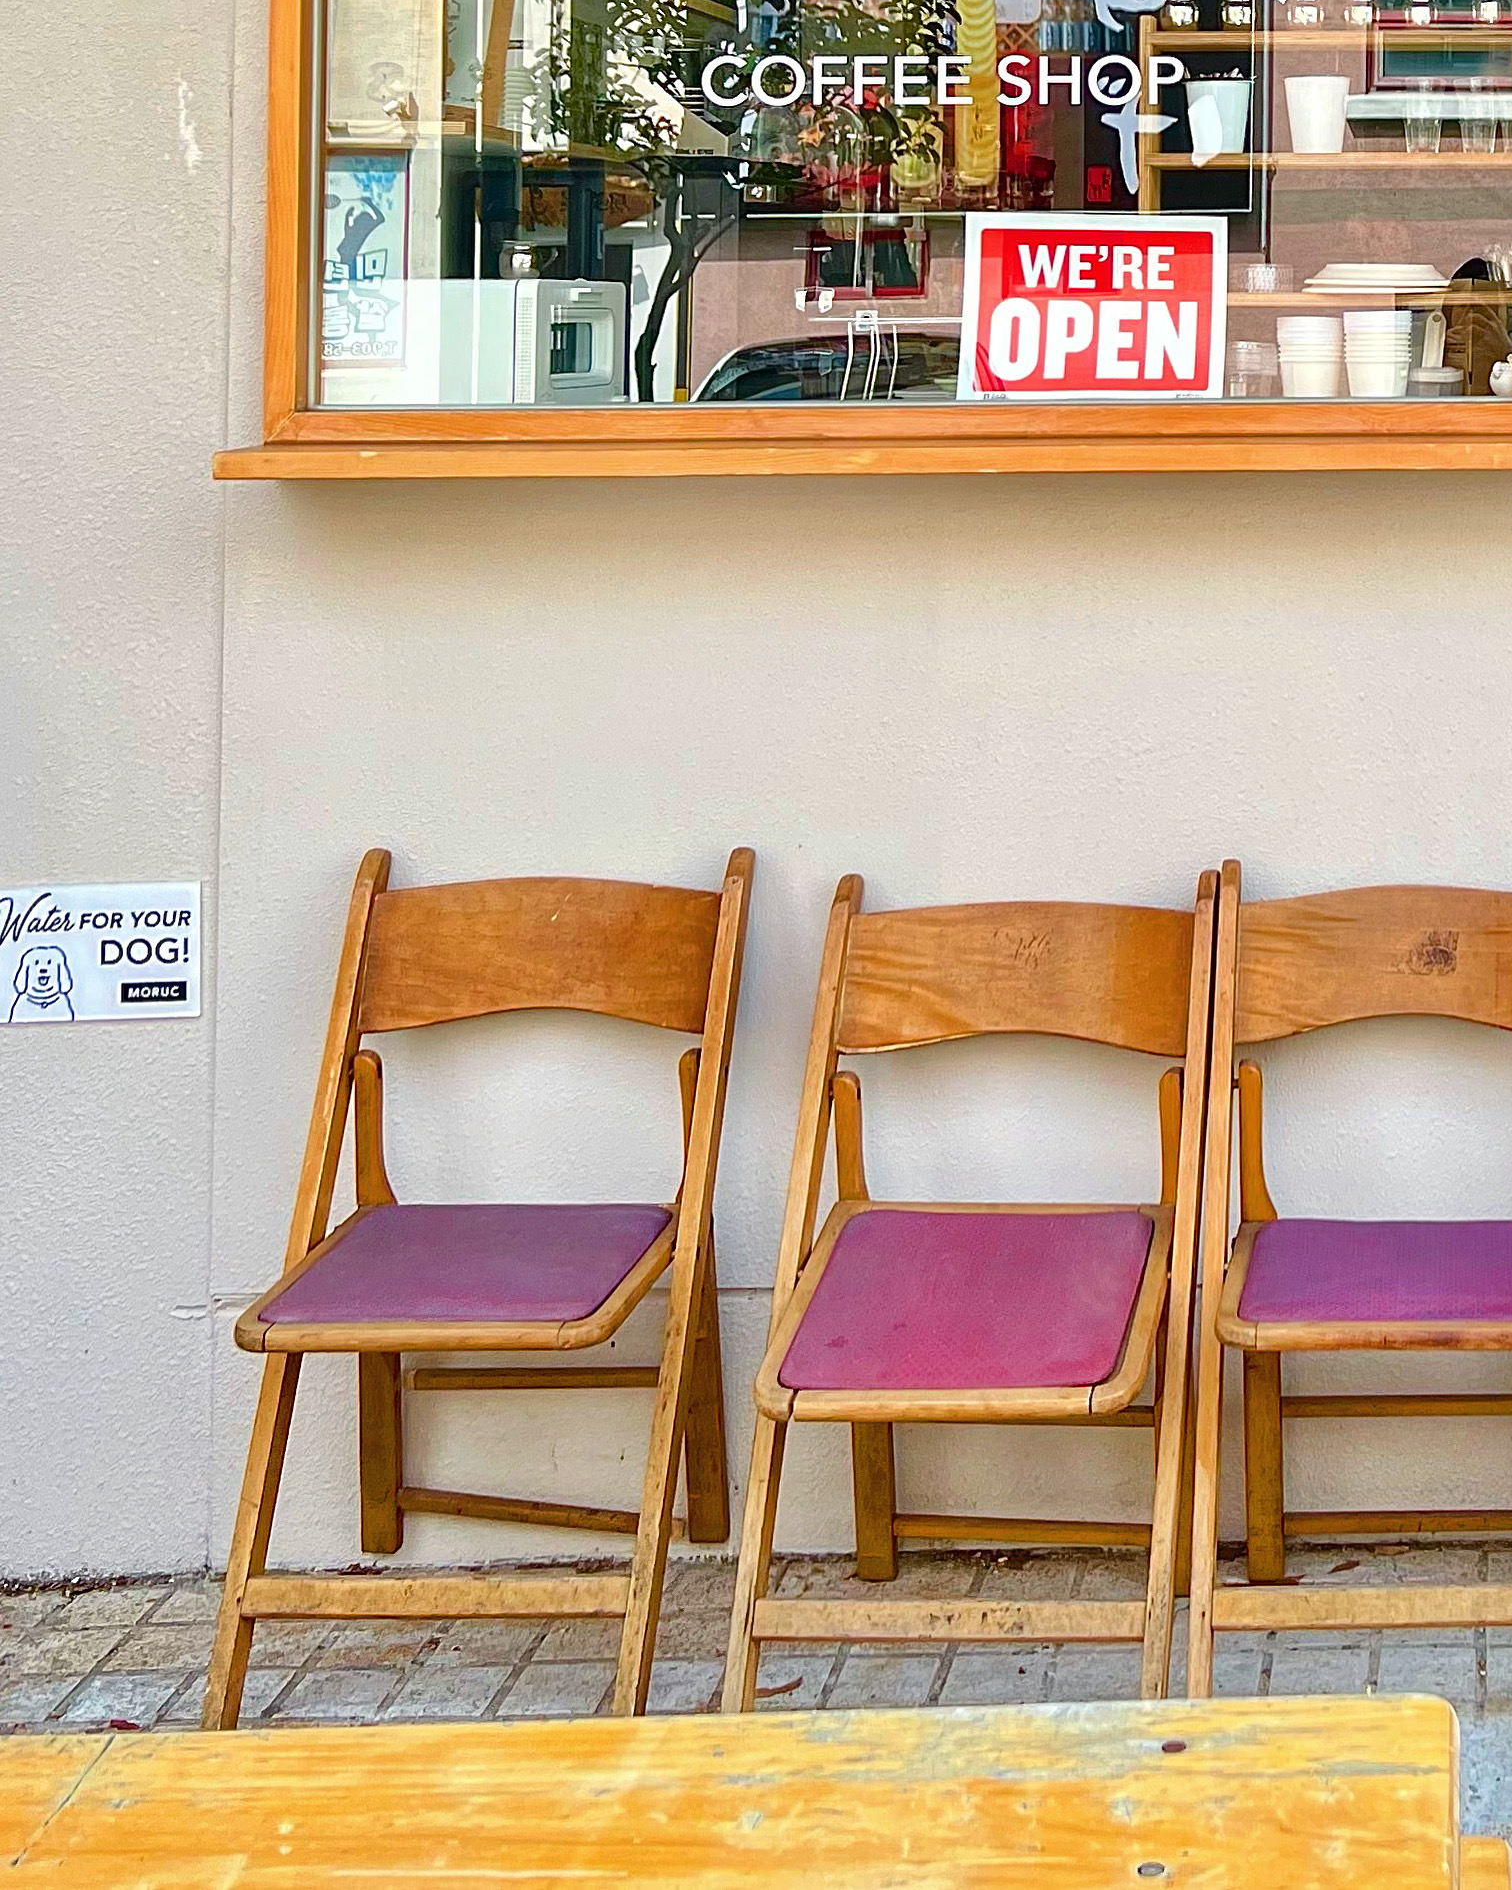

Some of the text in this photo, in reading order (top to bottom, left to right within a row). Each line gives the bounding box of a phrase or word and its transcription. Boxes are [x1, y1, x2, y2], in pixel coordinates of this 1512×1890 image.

[700, 54, 1185, 108] COFFEE SHOP
[1018, 244, 1175, 290] WE'RE
[988, 297, 1198, 381] OPEN
[0, 893, 191, 946] Water FOR YOUR
[100, 937, 189, 965] DOG!
[128, 986, 180, 998] MORUC
